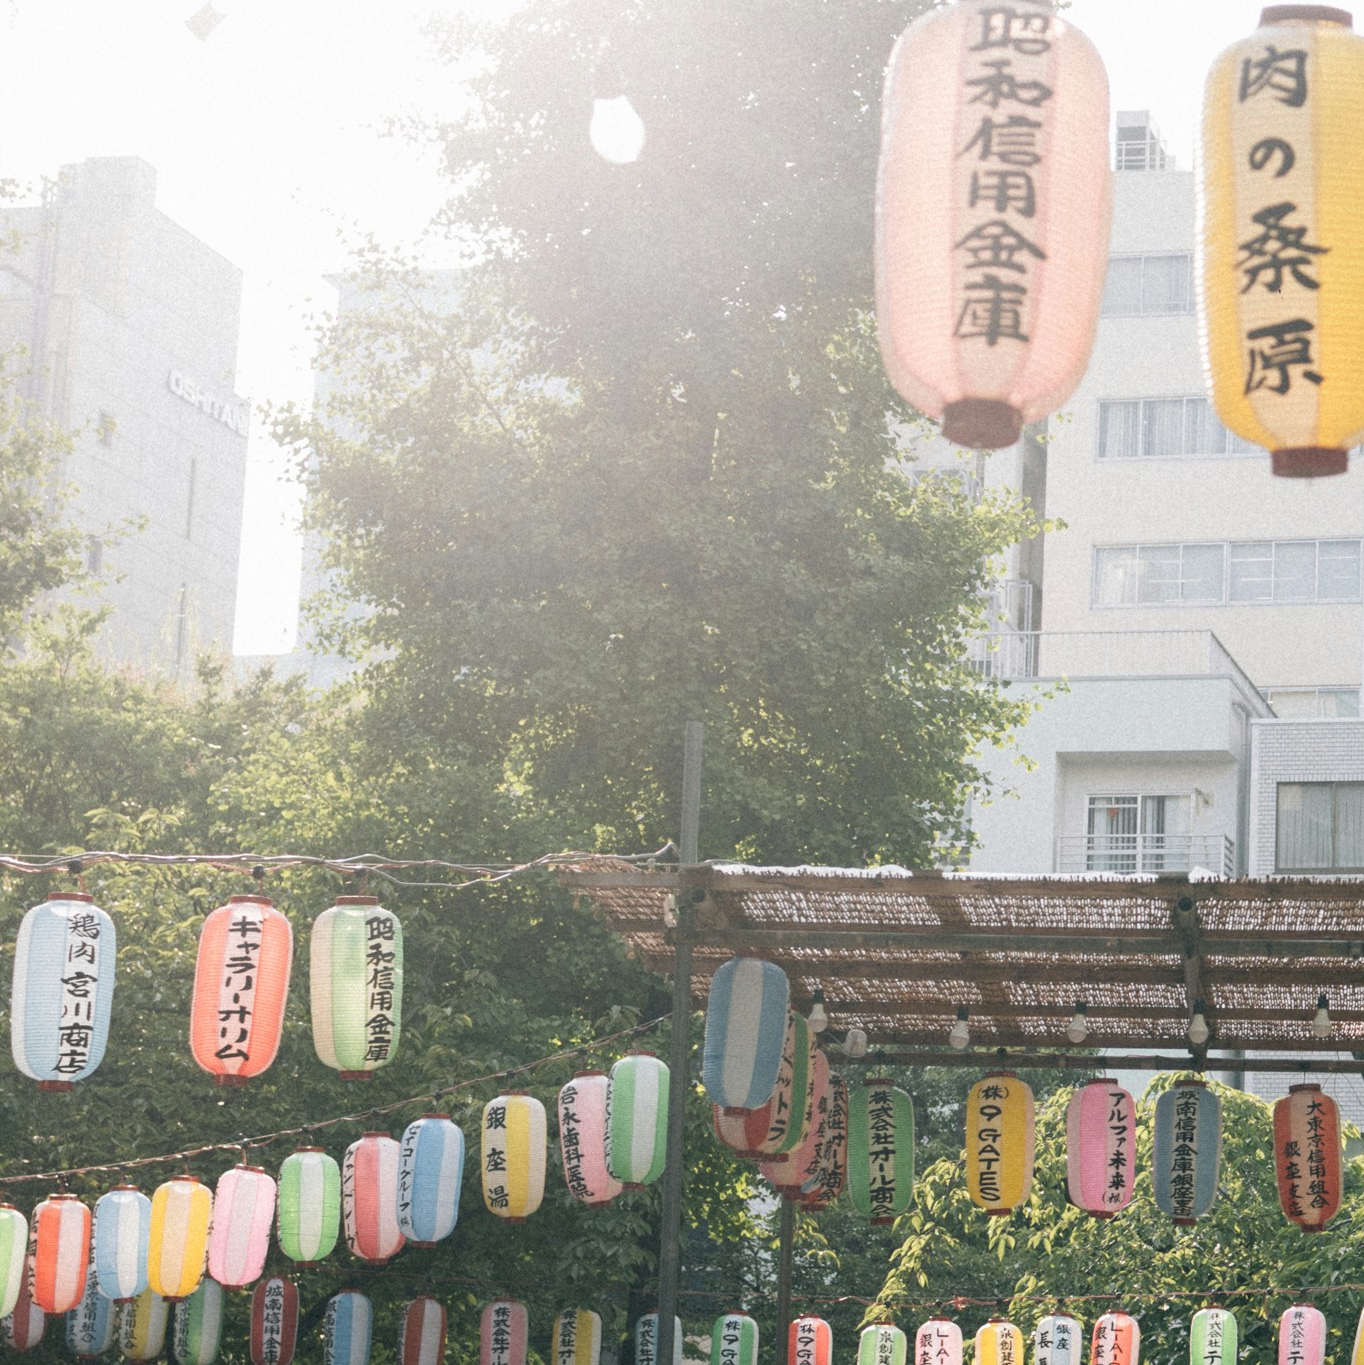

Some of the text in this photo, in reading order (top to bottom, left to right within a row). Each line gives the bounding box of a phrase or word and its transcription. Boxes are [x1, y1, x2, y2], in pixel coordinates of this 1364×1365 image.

[953, 7, 1053, 346] 昭和信用金庫
[1236, 45, 1331, 397] 肉の桑原
[214, 916, 265, 1062] ギャラリーオリム
[362, 916, 396, 1063] 昭和信用金庫
[486, 1106, 509, 1209] 銀座湯
[868, 1090, 897, 1217] 株式会社オール商会
[1170, 1090, 1200, 1217] 城南信用金庫銀座支店
[1305, 1099, 1331, 1210] 大東京信用組合
[262, 1285, 284, 1365] 城南信用金庫
[1056, 1323, 1071, 1351] 銀座
